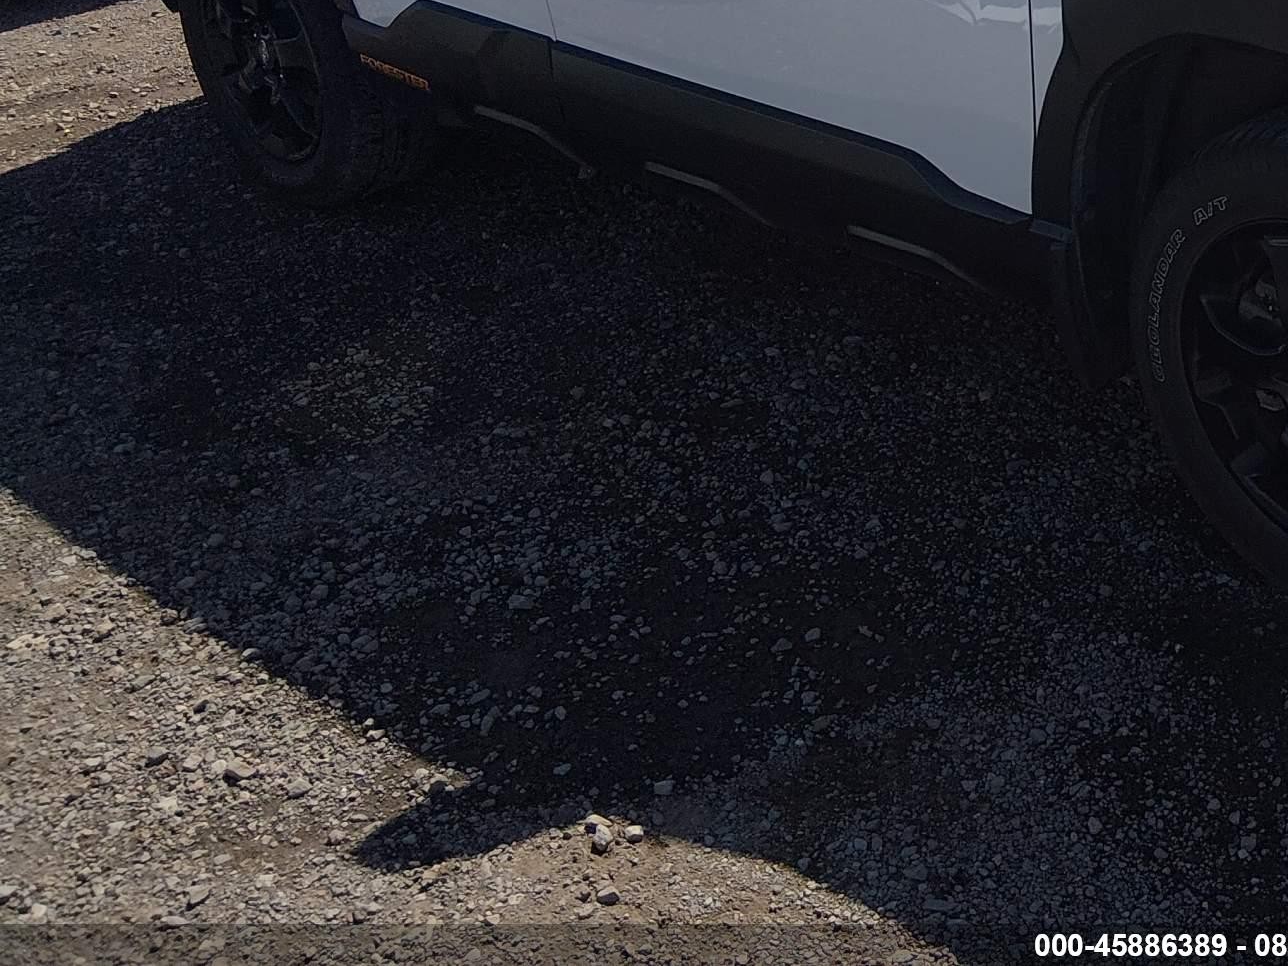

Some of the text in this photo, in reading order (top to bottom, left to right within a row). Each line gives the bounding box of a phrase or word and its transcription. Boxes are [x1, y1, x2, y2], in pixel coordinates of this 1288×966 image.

[359, 52, 430, 91] FORESTER
[1145, 195, 1229, 383] GEOLANDAR A/T
